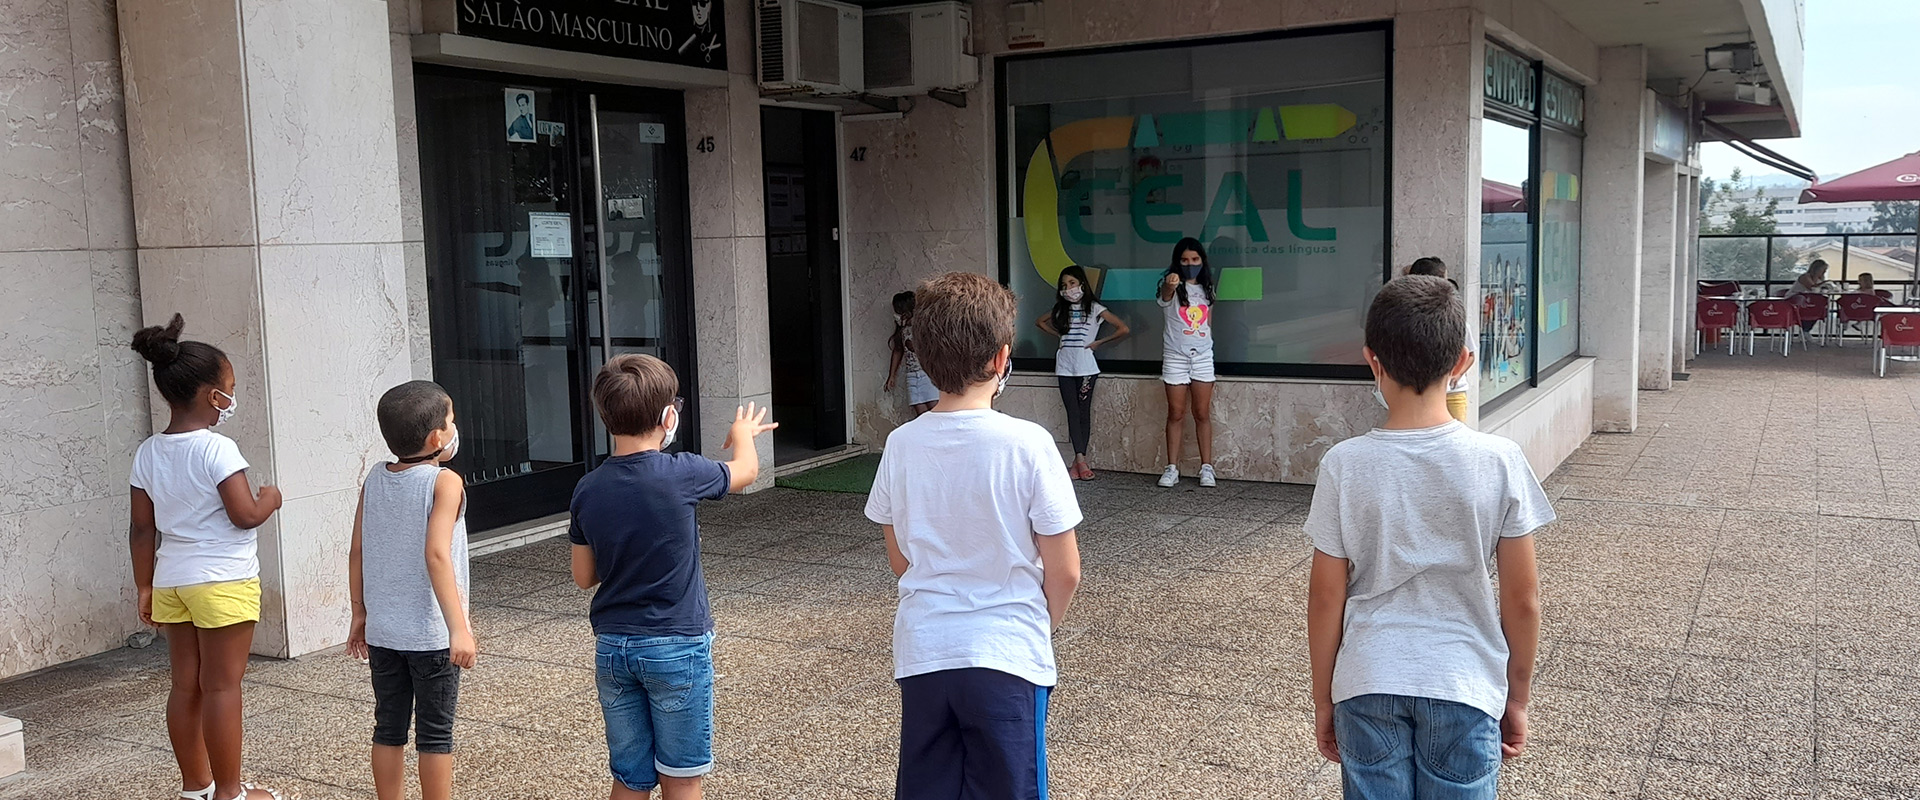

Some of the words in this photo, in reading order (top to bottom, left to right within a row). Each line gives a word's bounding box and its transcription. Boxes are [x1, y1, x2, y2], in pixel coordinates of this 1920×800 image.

[463, 1, 544, 33] SALÃO
[549, 10, 673, 51] MASCULINO
[1484, 46, 1525, 108] ENTRO
[1528, 67, 1537, 112] D
[696, 136, 715, 153] 45
[850, 147, 867, 161] 47
[1064, 169, 1337, 245] CEAL
[1262, 243, 1285, 255] das
[1288, 243, 1336, 259] línguas
